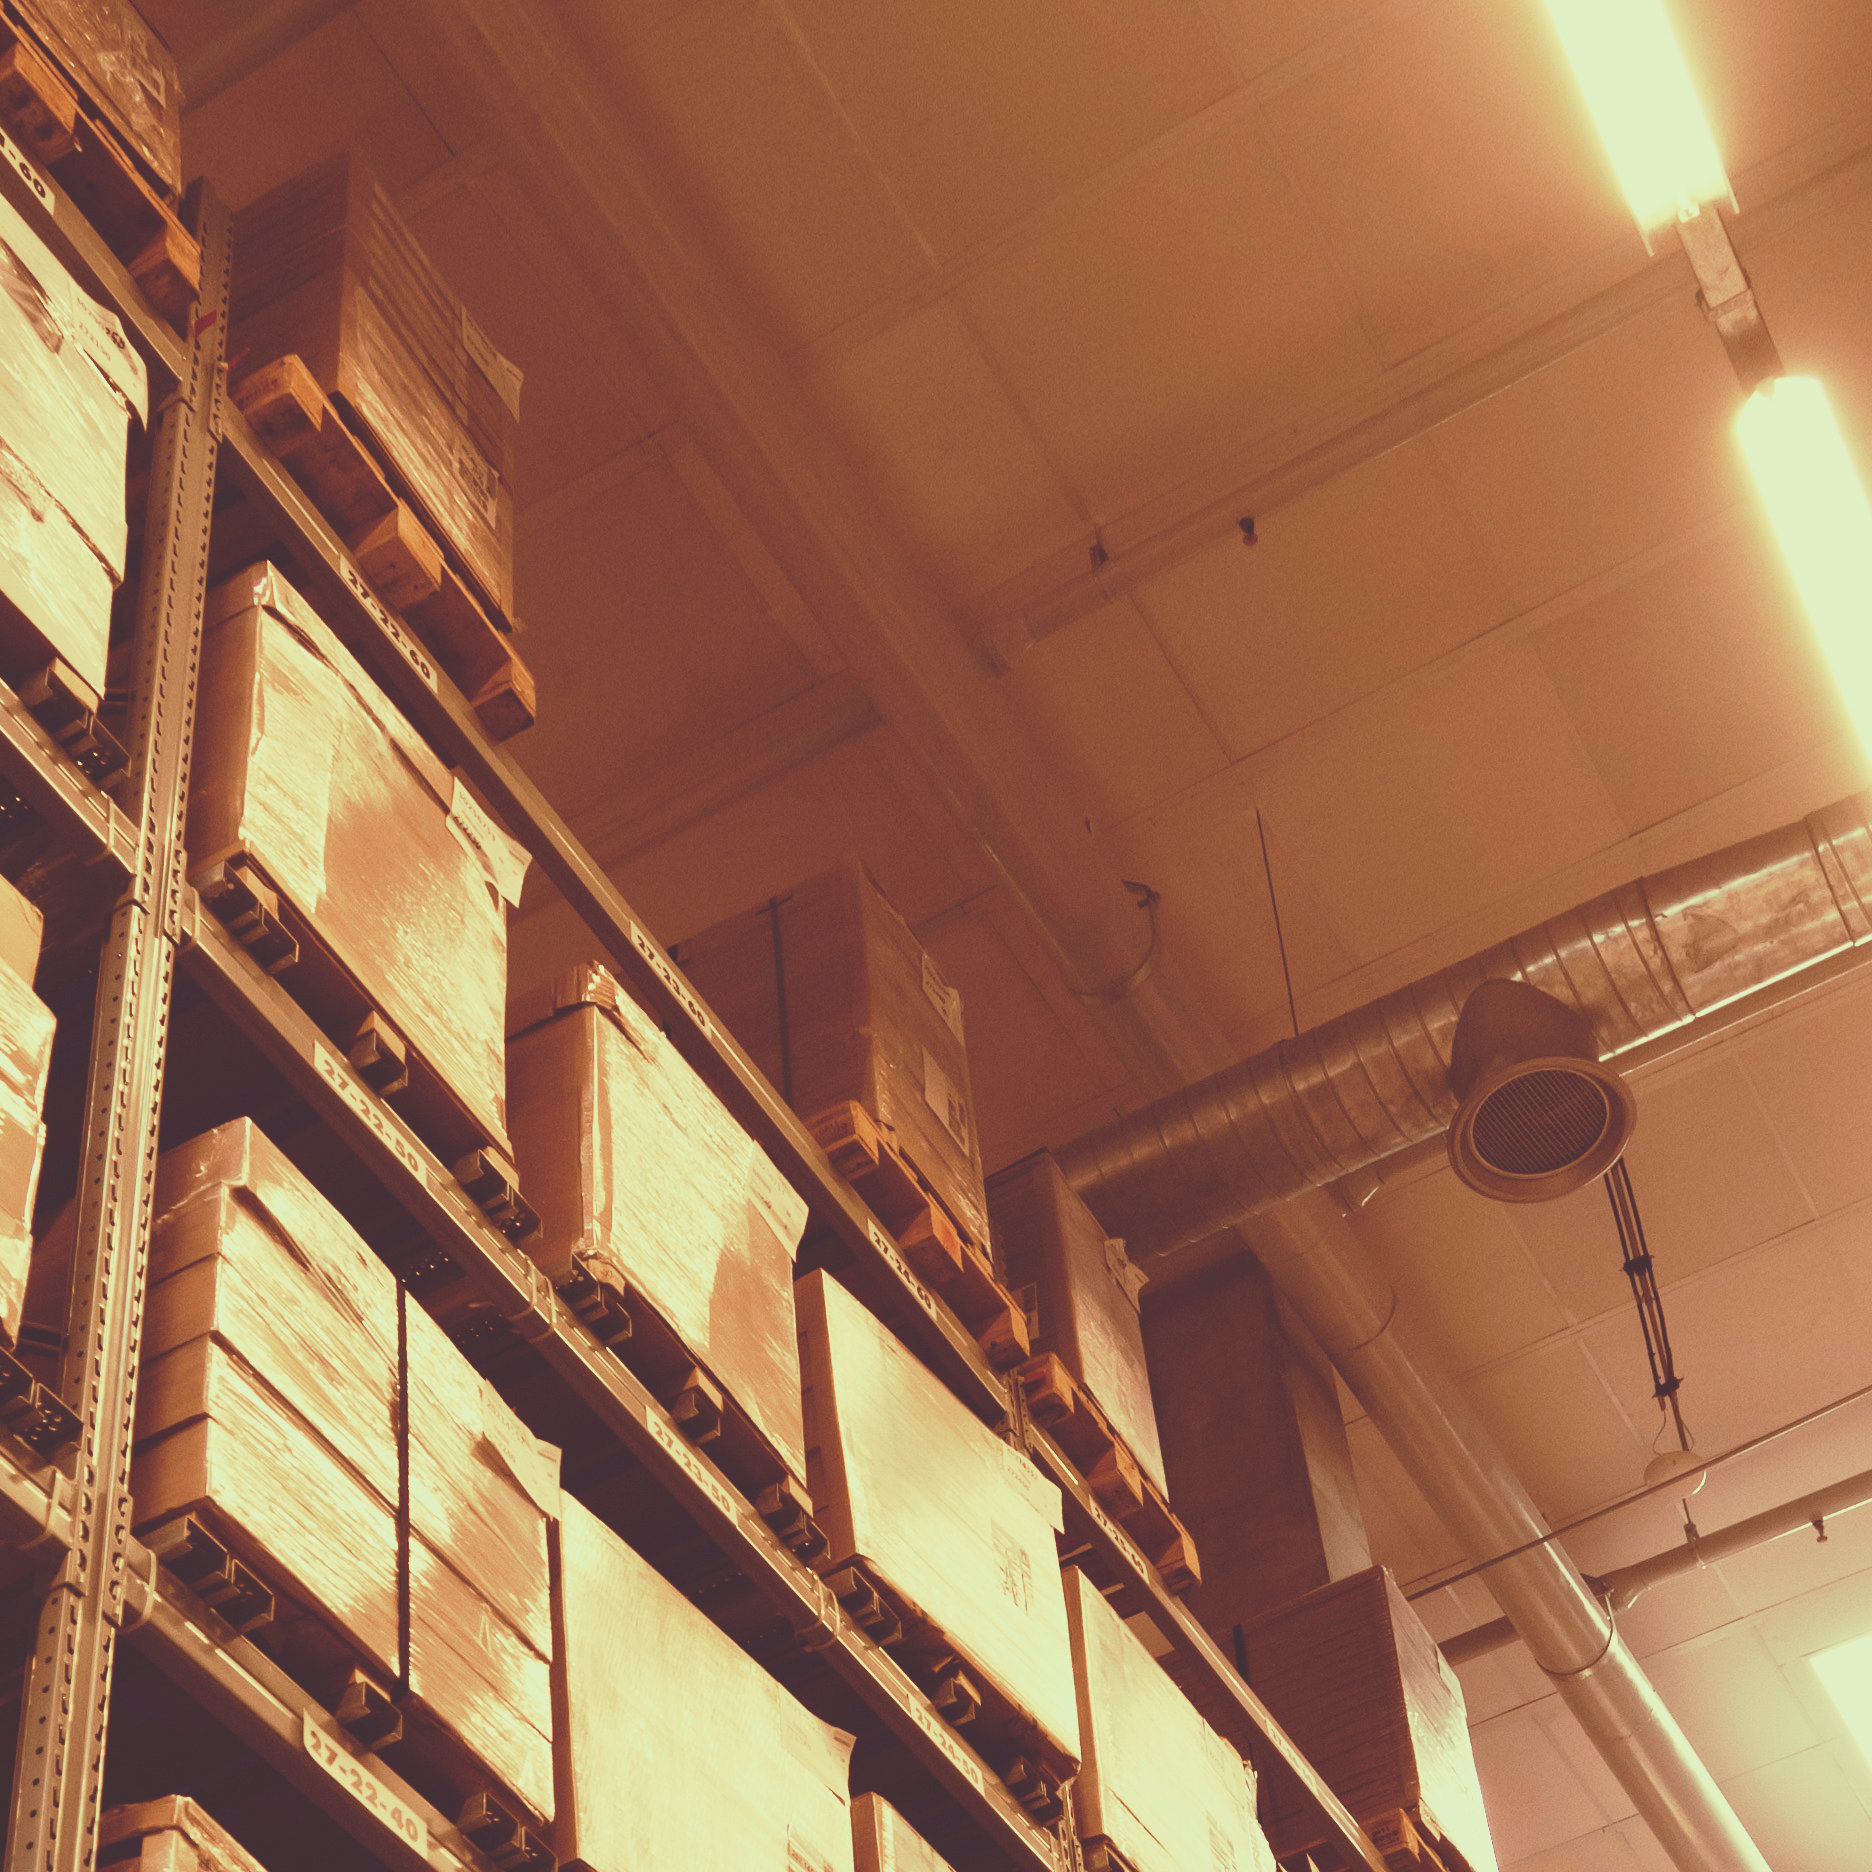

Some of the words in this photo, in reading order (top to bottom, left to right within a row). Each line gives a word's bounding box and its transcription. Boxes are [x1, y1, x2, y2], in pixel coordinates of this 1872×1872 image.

[348, 569, 430, 680] 27-22-60
[636, 933, 707, 1028] 27-23-60
[324, 1059, 419, 1174] 27-22-50
[873, 1230, 933, 1311] 27-24-60
[654, 1420, 731, 1514] 27-23-50
[309, 1729, 419, 1843] 27-22-40
[915, 1705, 979, 1785] 27-24-50
